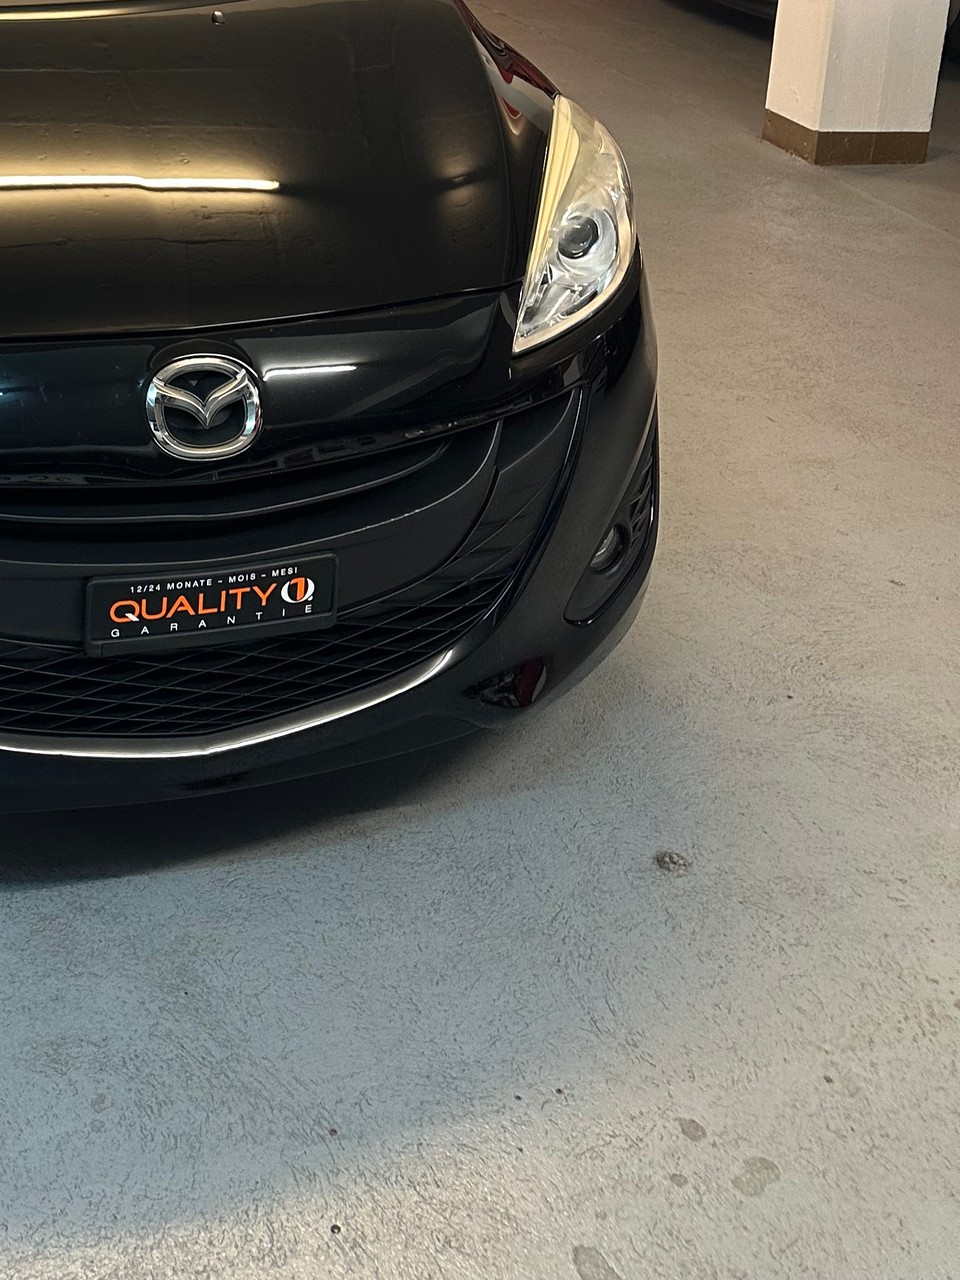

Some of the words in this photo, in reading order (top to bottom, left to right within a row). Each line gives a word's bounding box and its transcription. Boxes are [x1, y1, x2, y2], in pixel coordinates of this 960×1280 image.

[130, 583, 161, 594] 12/24
[167, 579, 213, 590] MONATE
[228, 572, 256, 583] MOIS
[271, 566, 299, 577] MESI
[109, 583, 277, 623] QUALITY
[110, 604, 312, 638] GARANTIE
